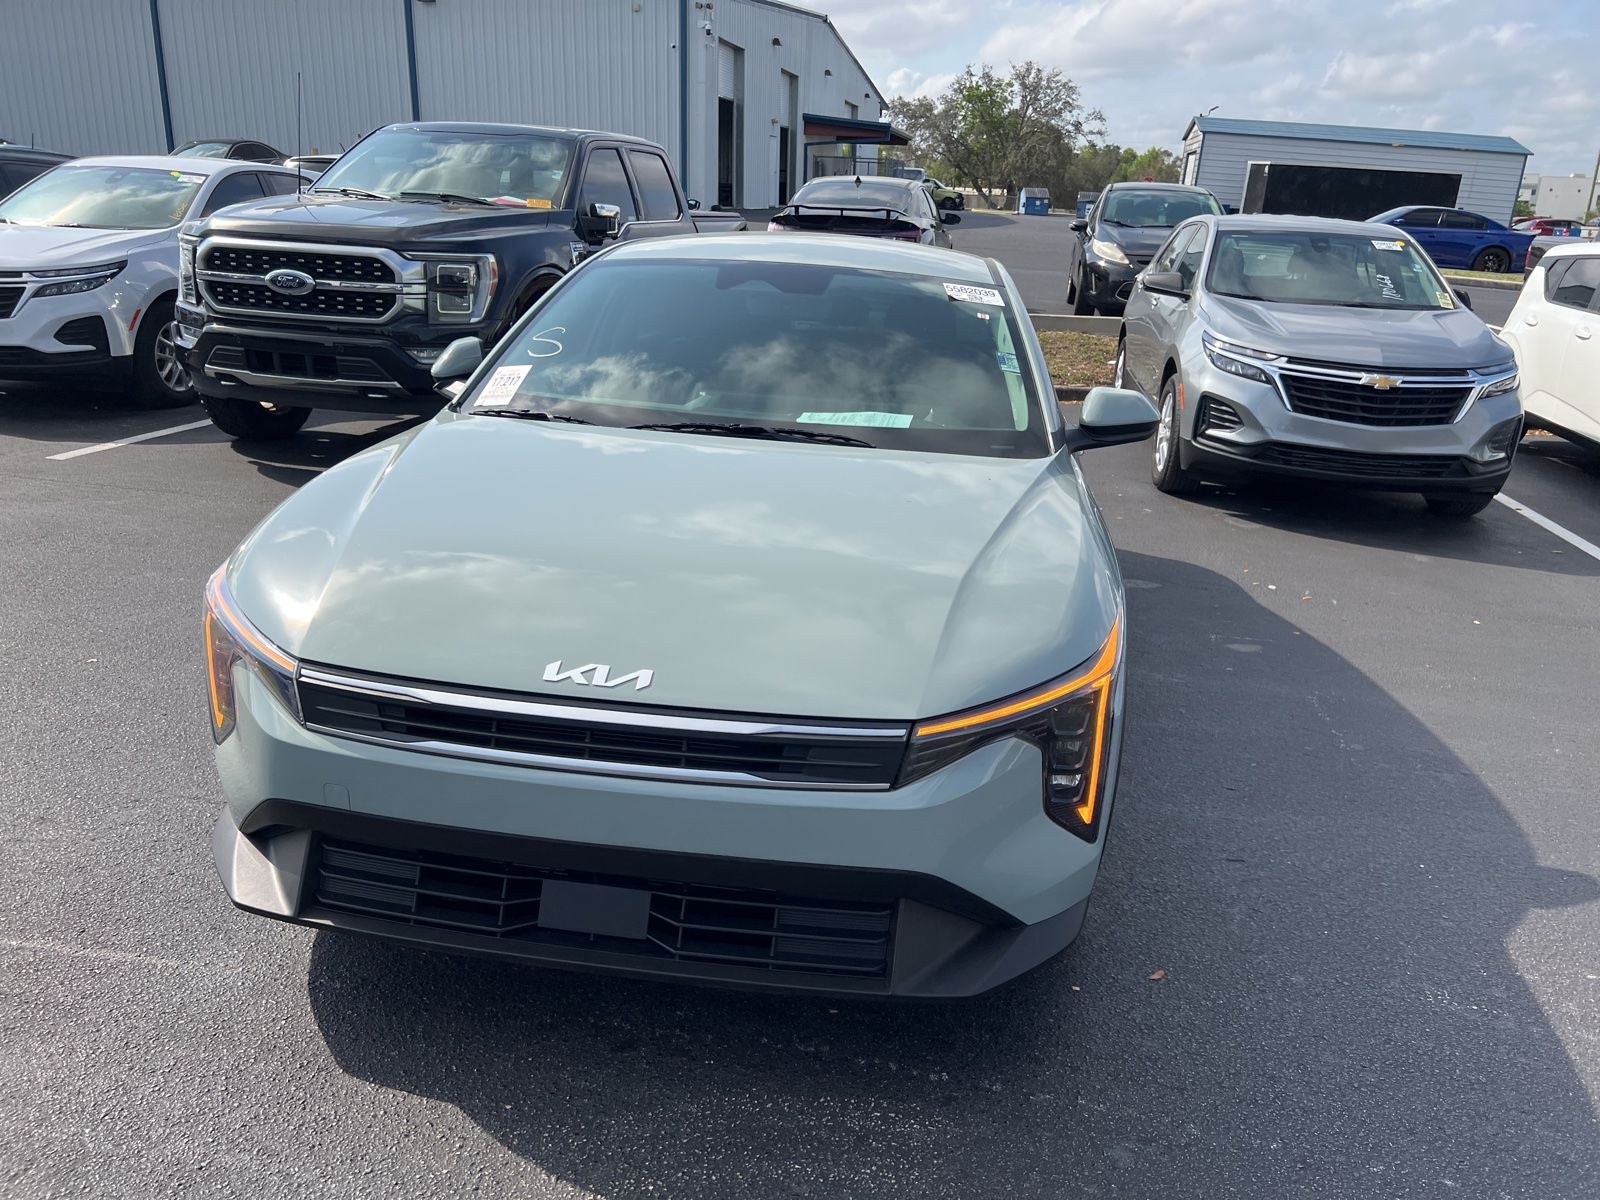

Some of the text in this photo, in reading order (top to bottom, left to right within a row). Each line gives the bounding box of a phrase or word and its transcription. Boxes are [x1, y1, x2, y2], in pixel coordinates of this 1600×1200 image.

[945, 284, 996, 298] 5582039
[527, 326, 566, 358] S
[542, 659, 654, 691] KIA
